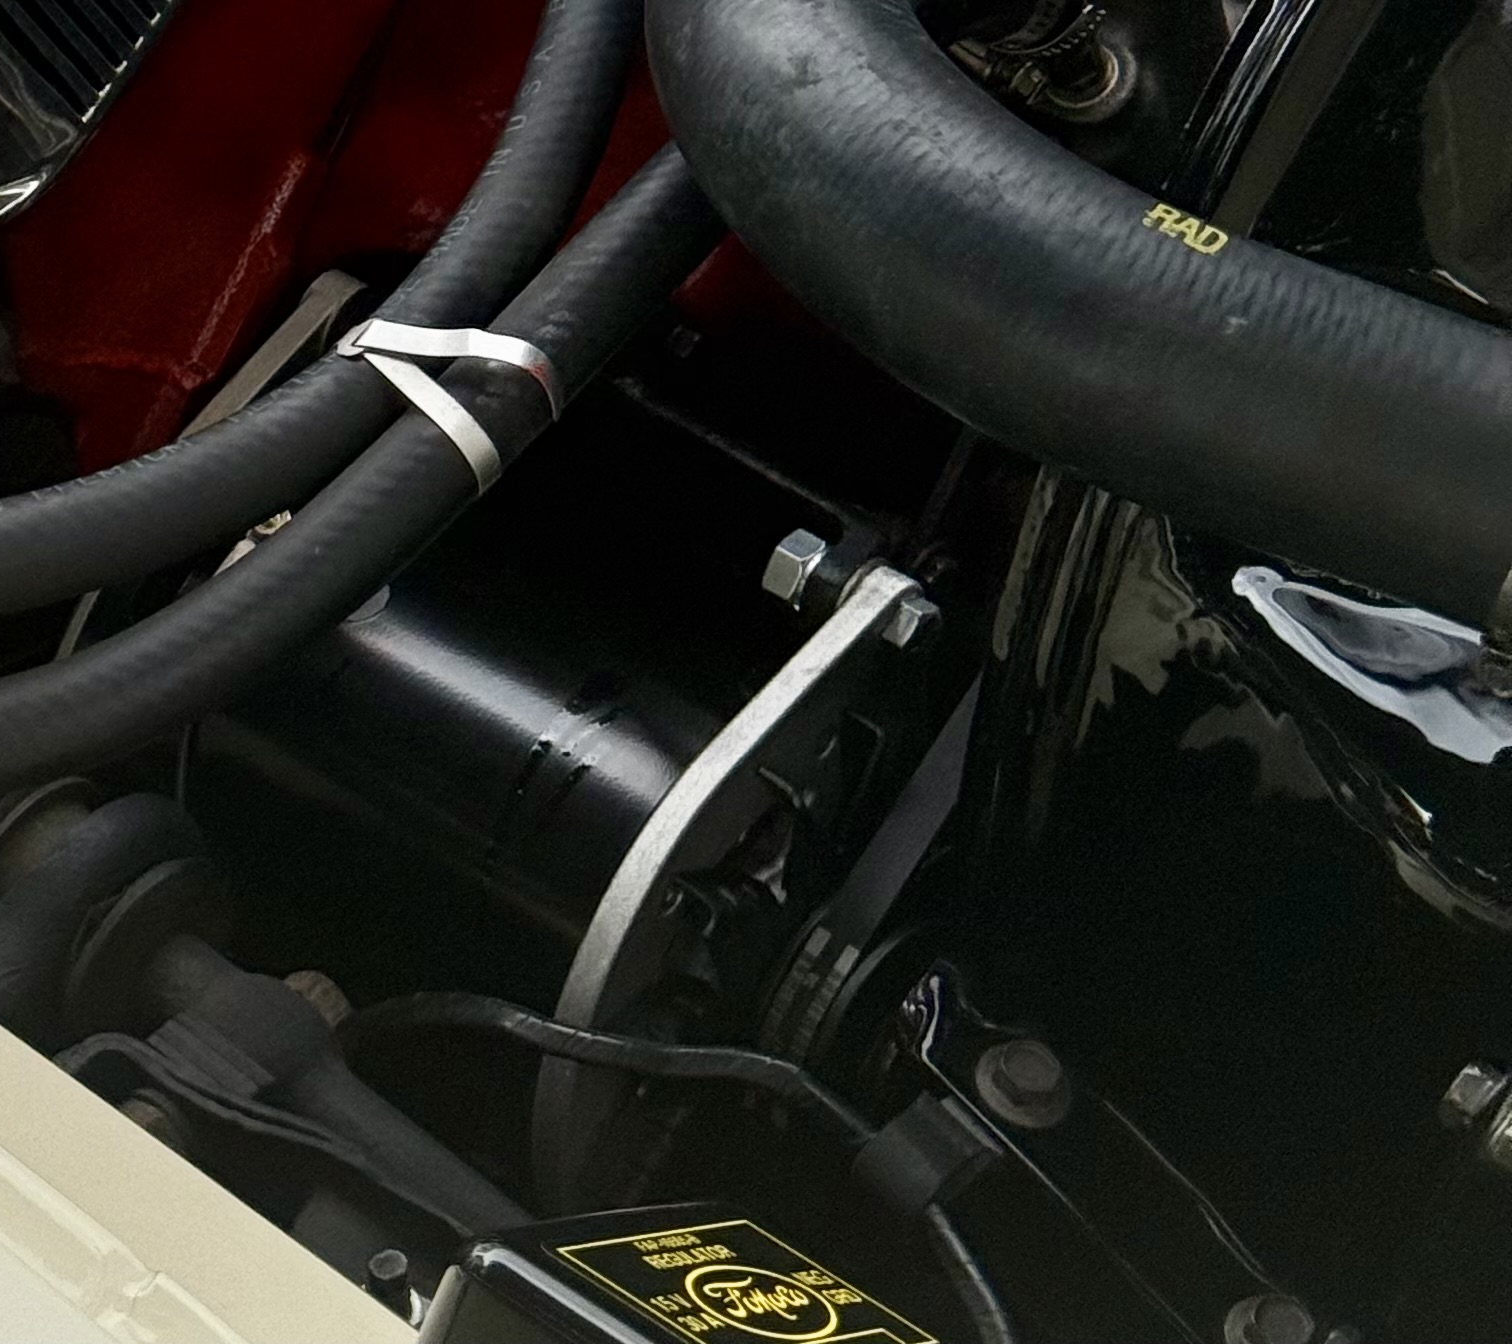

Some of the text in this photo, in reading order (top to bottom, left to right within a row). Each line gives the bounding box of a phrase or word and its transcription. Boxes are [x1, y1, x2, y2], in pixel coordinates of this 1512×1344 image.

[1142, 203, 1229, 256] RAD
[641, 1243, 738, 1270] REGULATOR
[791, 1269, 834, 1287] NEG
[650, 1293, 676, 1312] 15
[702, 1276, 814, 1320] FoMoCo
